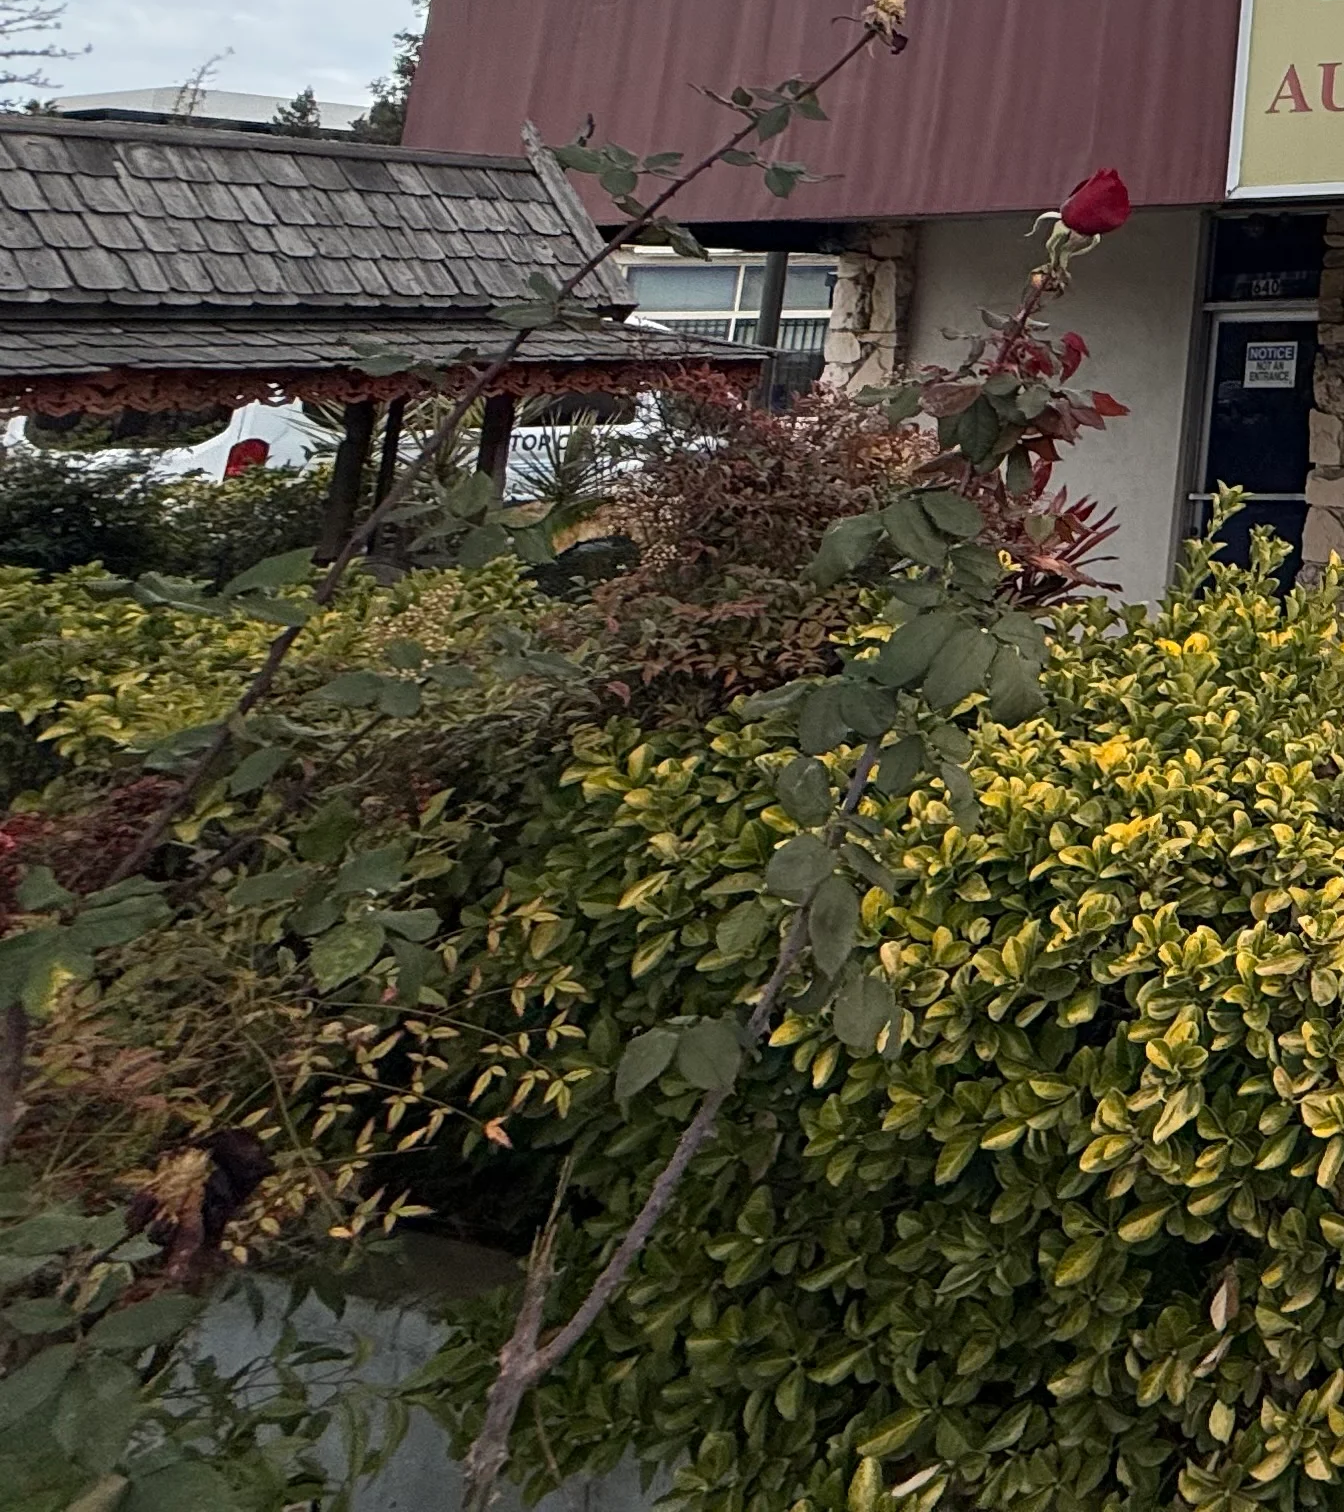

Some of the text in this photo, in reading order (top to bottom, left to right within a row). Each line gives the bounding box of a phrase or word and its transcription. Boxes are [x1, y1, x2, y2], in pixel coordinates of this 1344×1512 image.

[1253, 279, 1280, 294] 640
[1250, 347, 1293, 359] NOTICE
[1256, 361, 1285, 370] NOT AN
[1249, 371, 1290, 381] ENTRANCE
